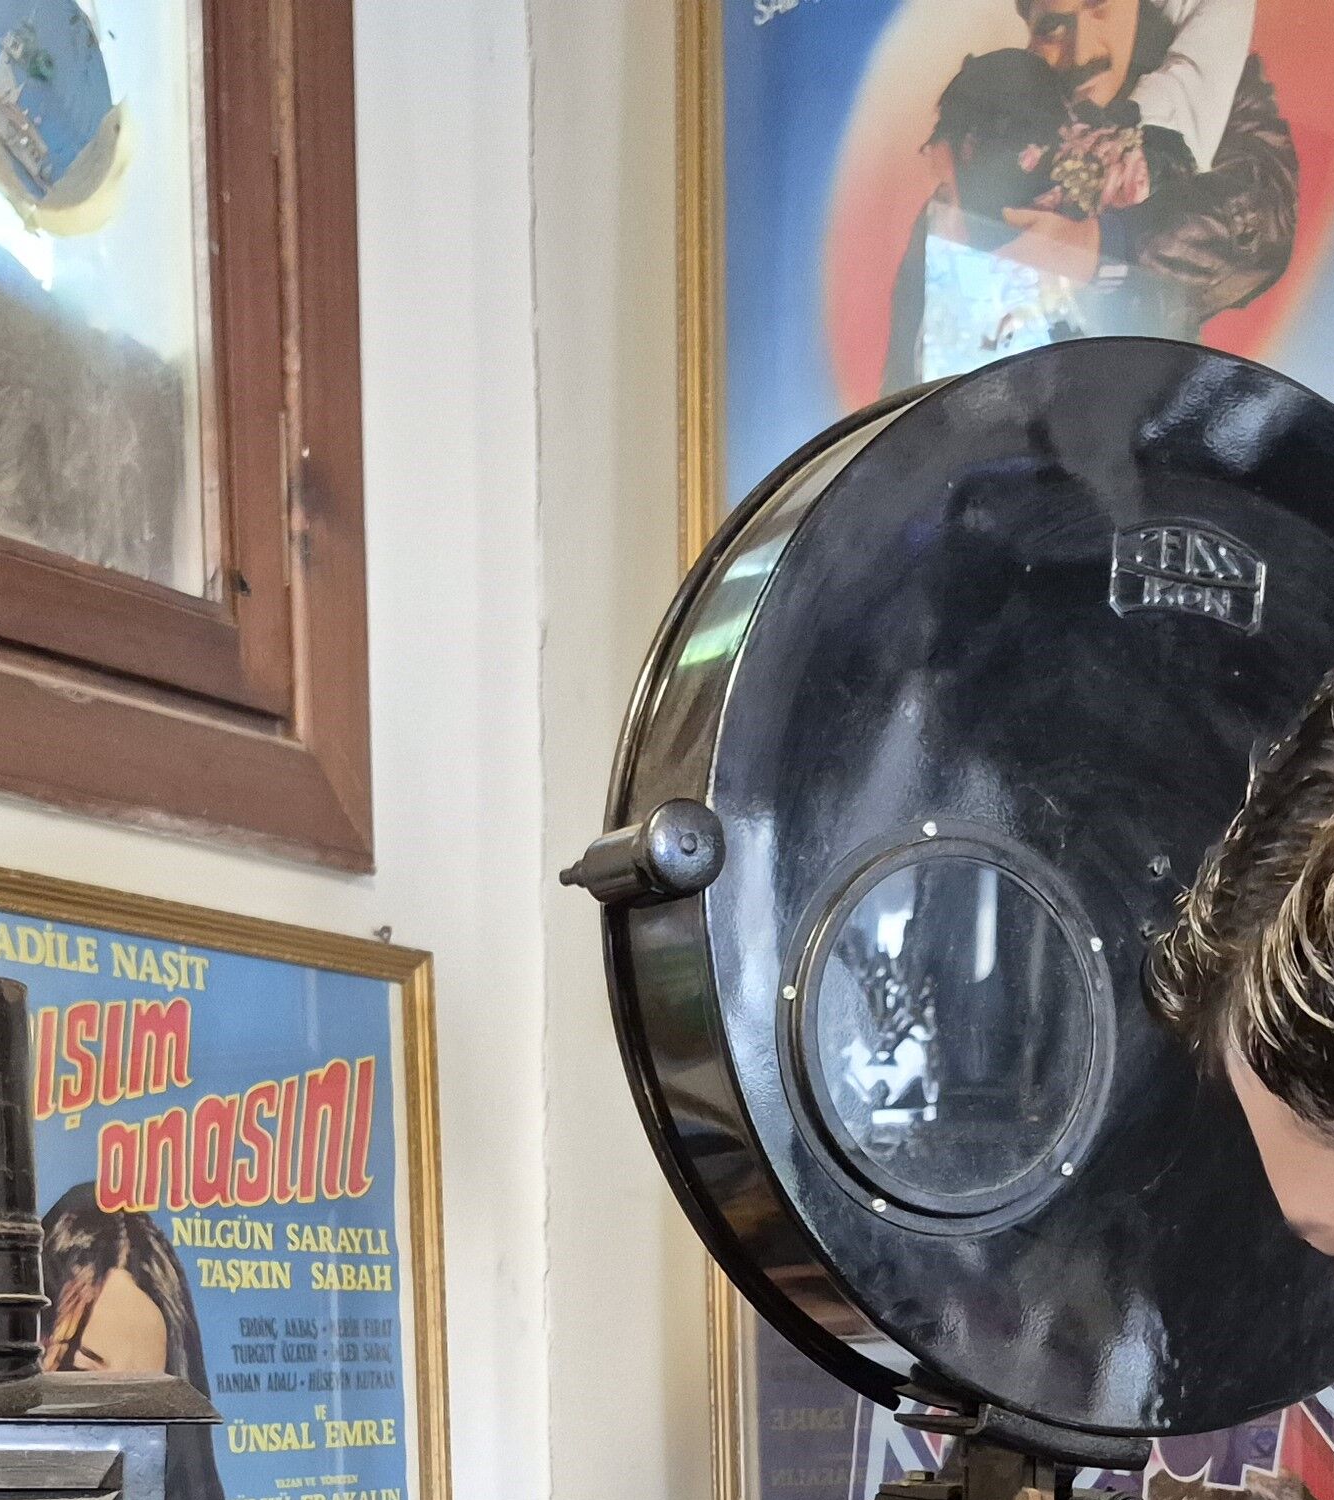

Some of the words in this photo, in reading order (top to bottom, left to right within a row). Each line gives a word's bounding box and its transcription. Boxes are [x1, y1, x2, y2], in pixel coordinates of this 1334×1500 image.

[109, 941, 210, 991] NAŞİT
[171, 1212, 273, 1251] NİLGÜN
[286, 1223, 390, 1255] SARAYLI
[197, 1258, 291, 1293] TAŞKIN
[311, 1261, 392, 1291] SABAH
[315, 1404, 327, 1421] VE
[227, 1419, 315, 1454] ÜNSAL
[325, 1419, 396, 1449] EMRE
